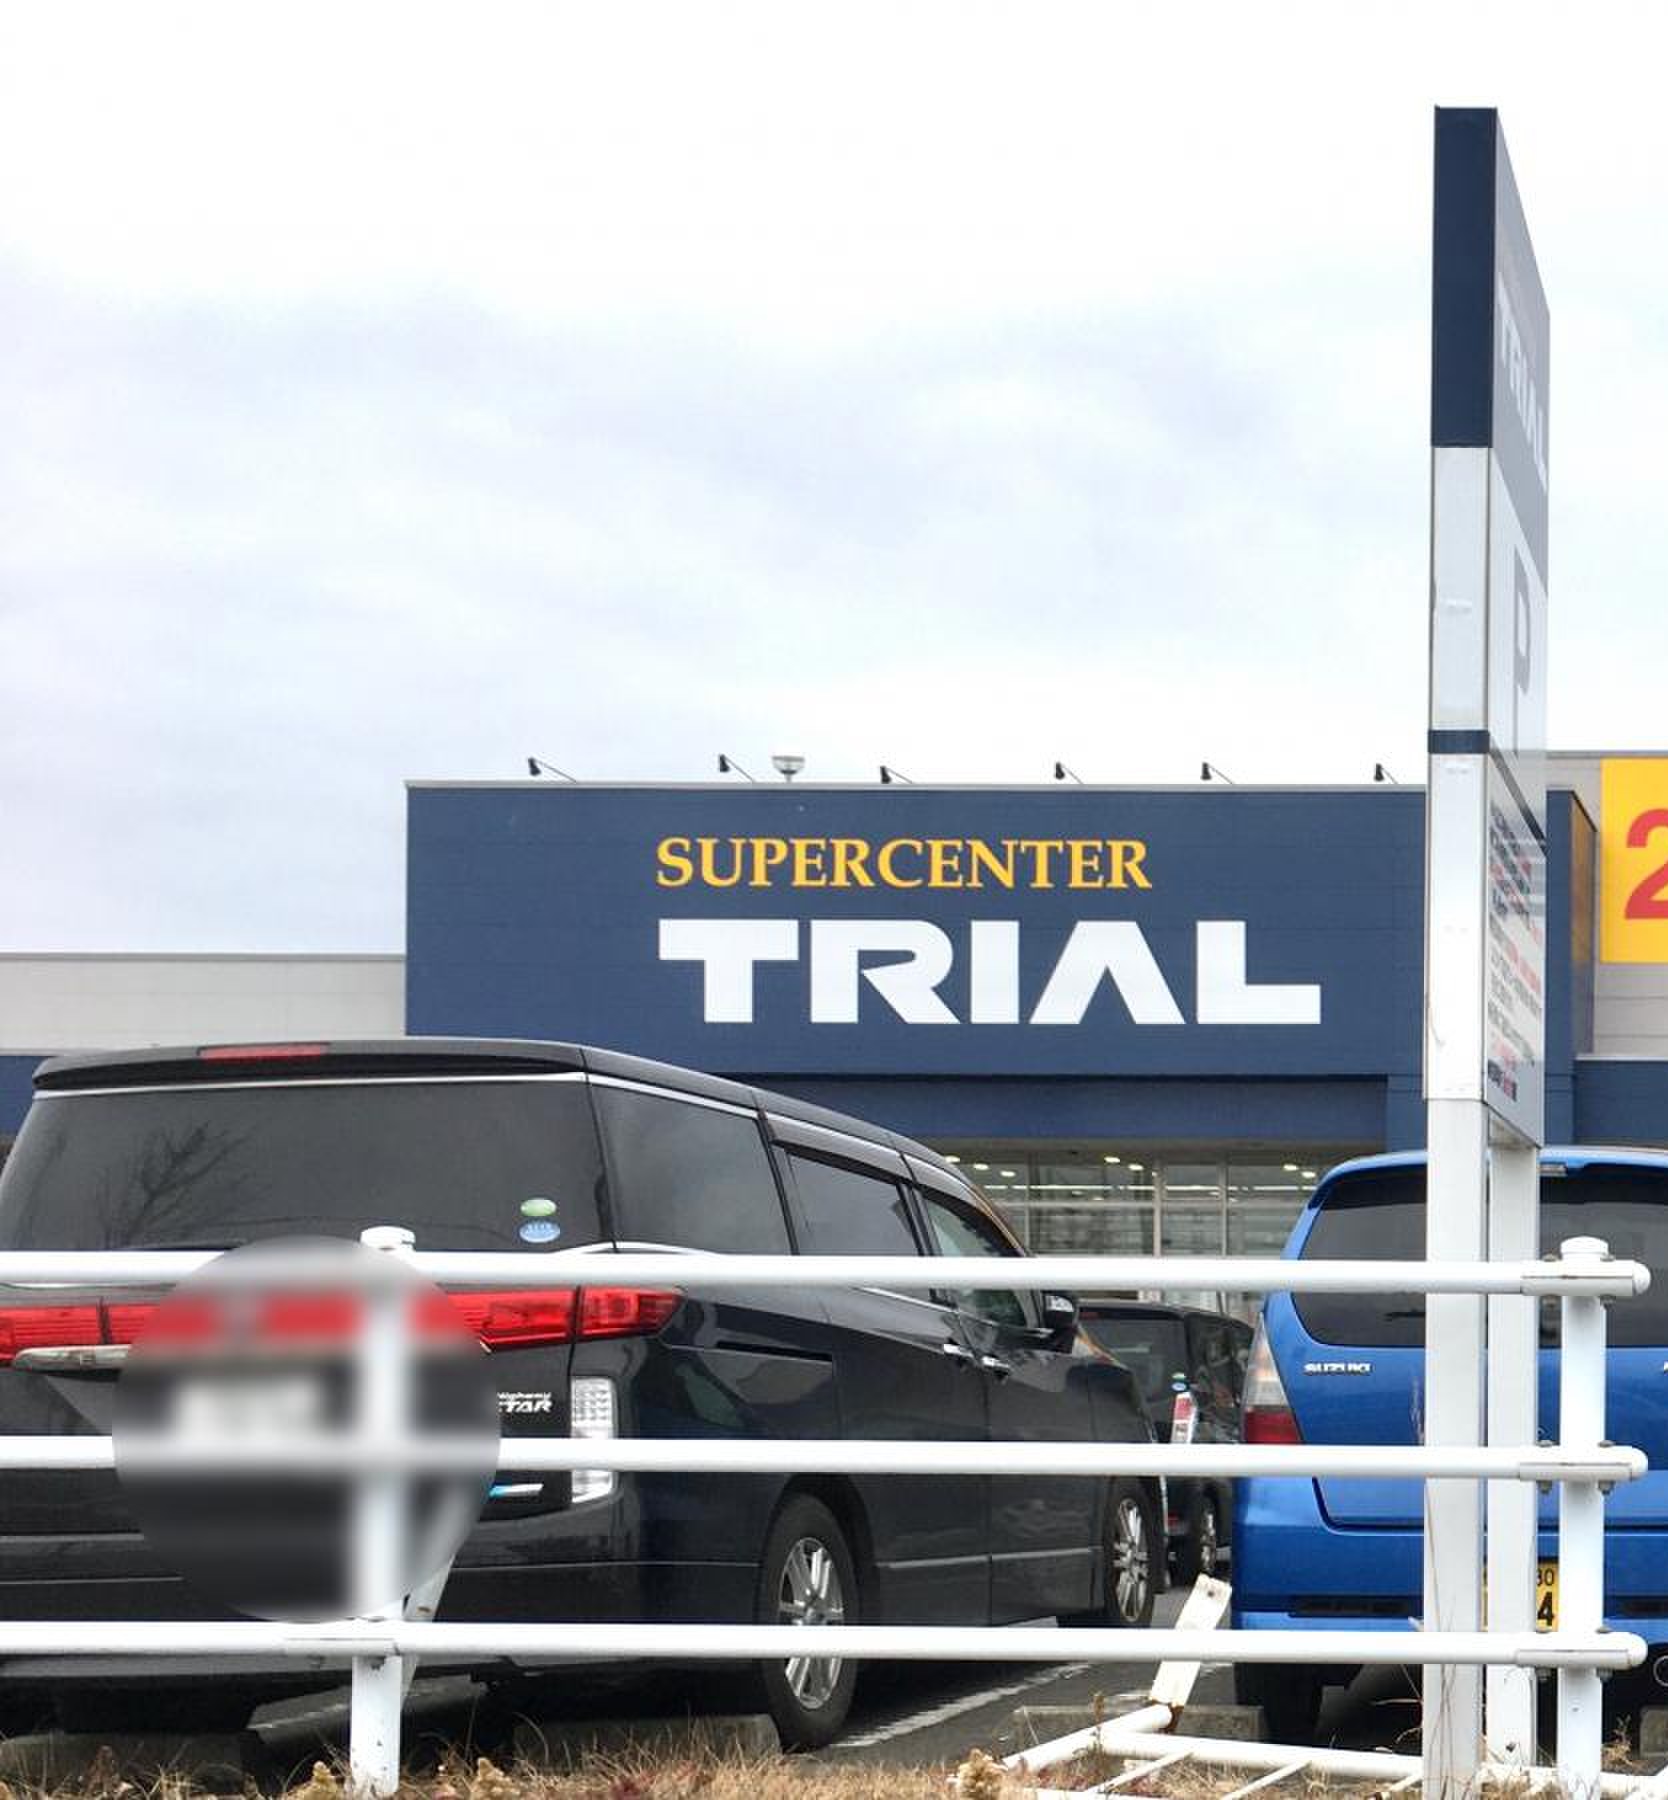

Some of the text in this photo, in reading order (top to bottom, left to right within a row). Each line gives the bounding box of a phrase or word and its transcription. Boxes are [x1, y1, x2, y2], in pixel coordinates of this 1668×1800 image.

[1497, 272, 1548, 495] TRIAL
[1513, 546, 1531, 757] P
[656, 836, 1152, 889] SUPERCENTER
[659, 919, 1321, 1024] TRIAL
